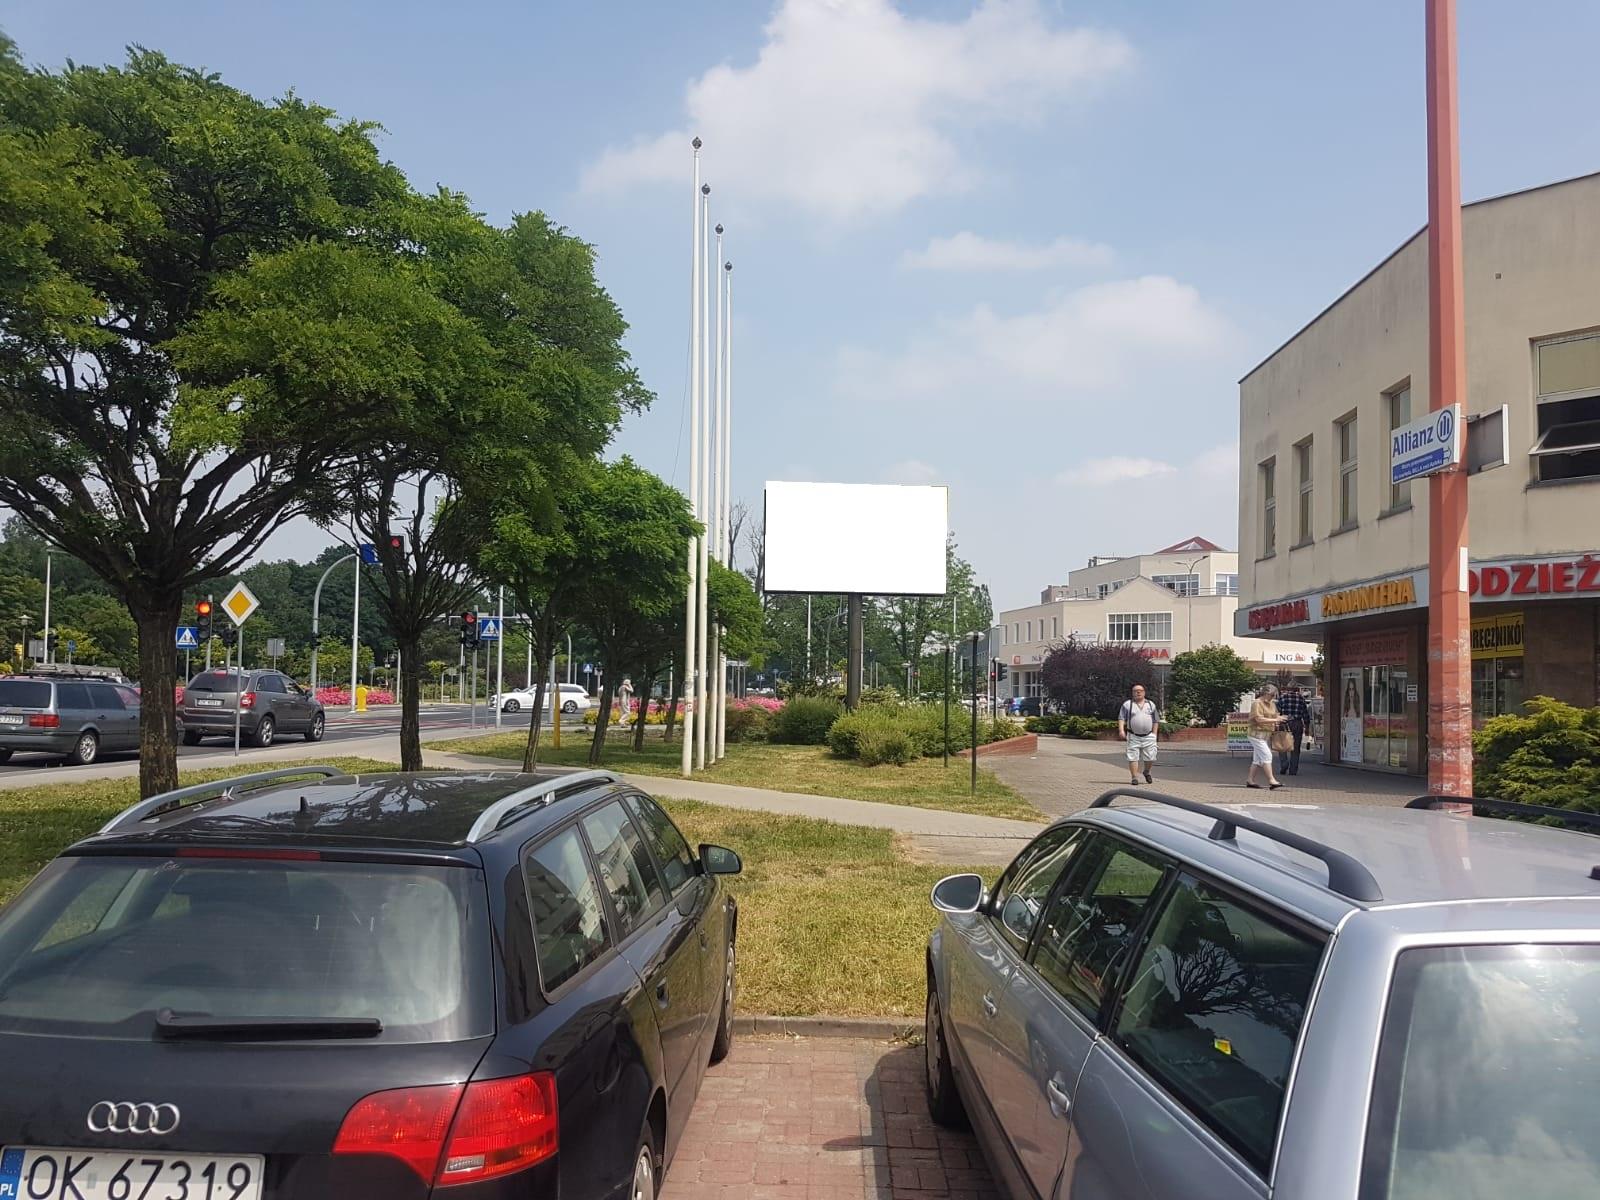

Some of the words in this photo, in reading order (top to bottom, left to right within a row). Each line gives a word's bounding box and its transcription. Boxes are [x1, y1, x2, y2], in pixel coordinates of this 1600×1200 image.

[1392, 426, 1434, 458] Allianz
[1321, 576, 1417, 618] PASMANTERIA
[1275, 653, 1293, 662] ING
[27, 1155, 94, 1200] OK
[108, 1158, 252, 1200] 67319
